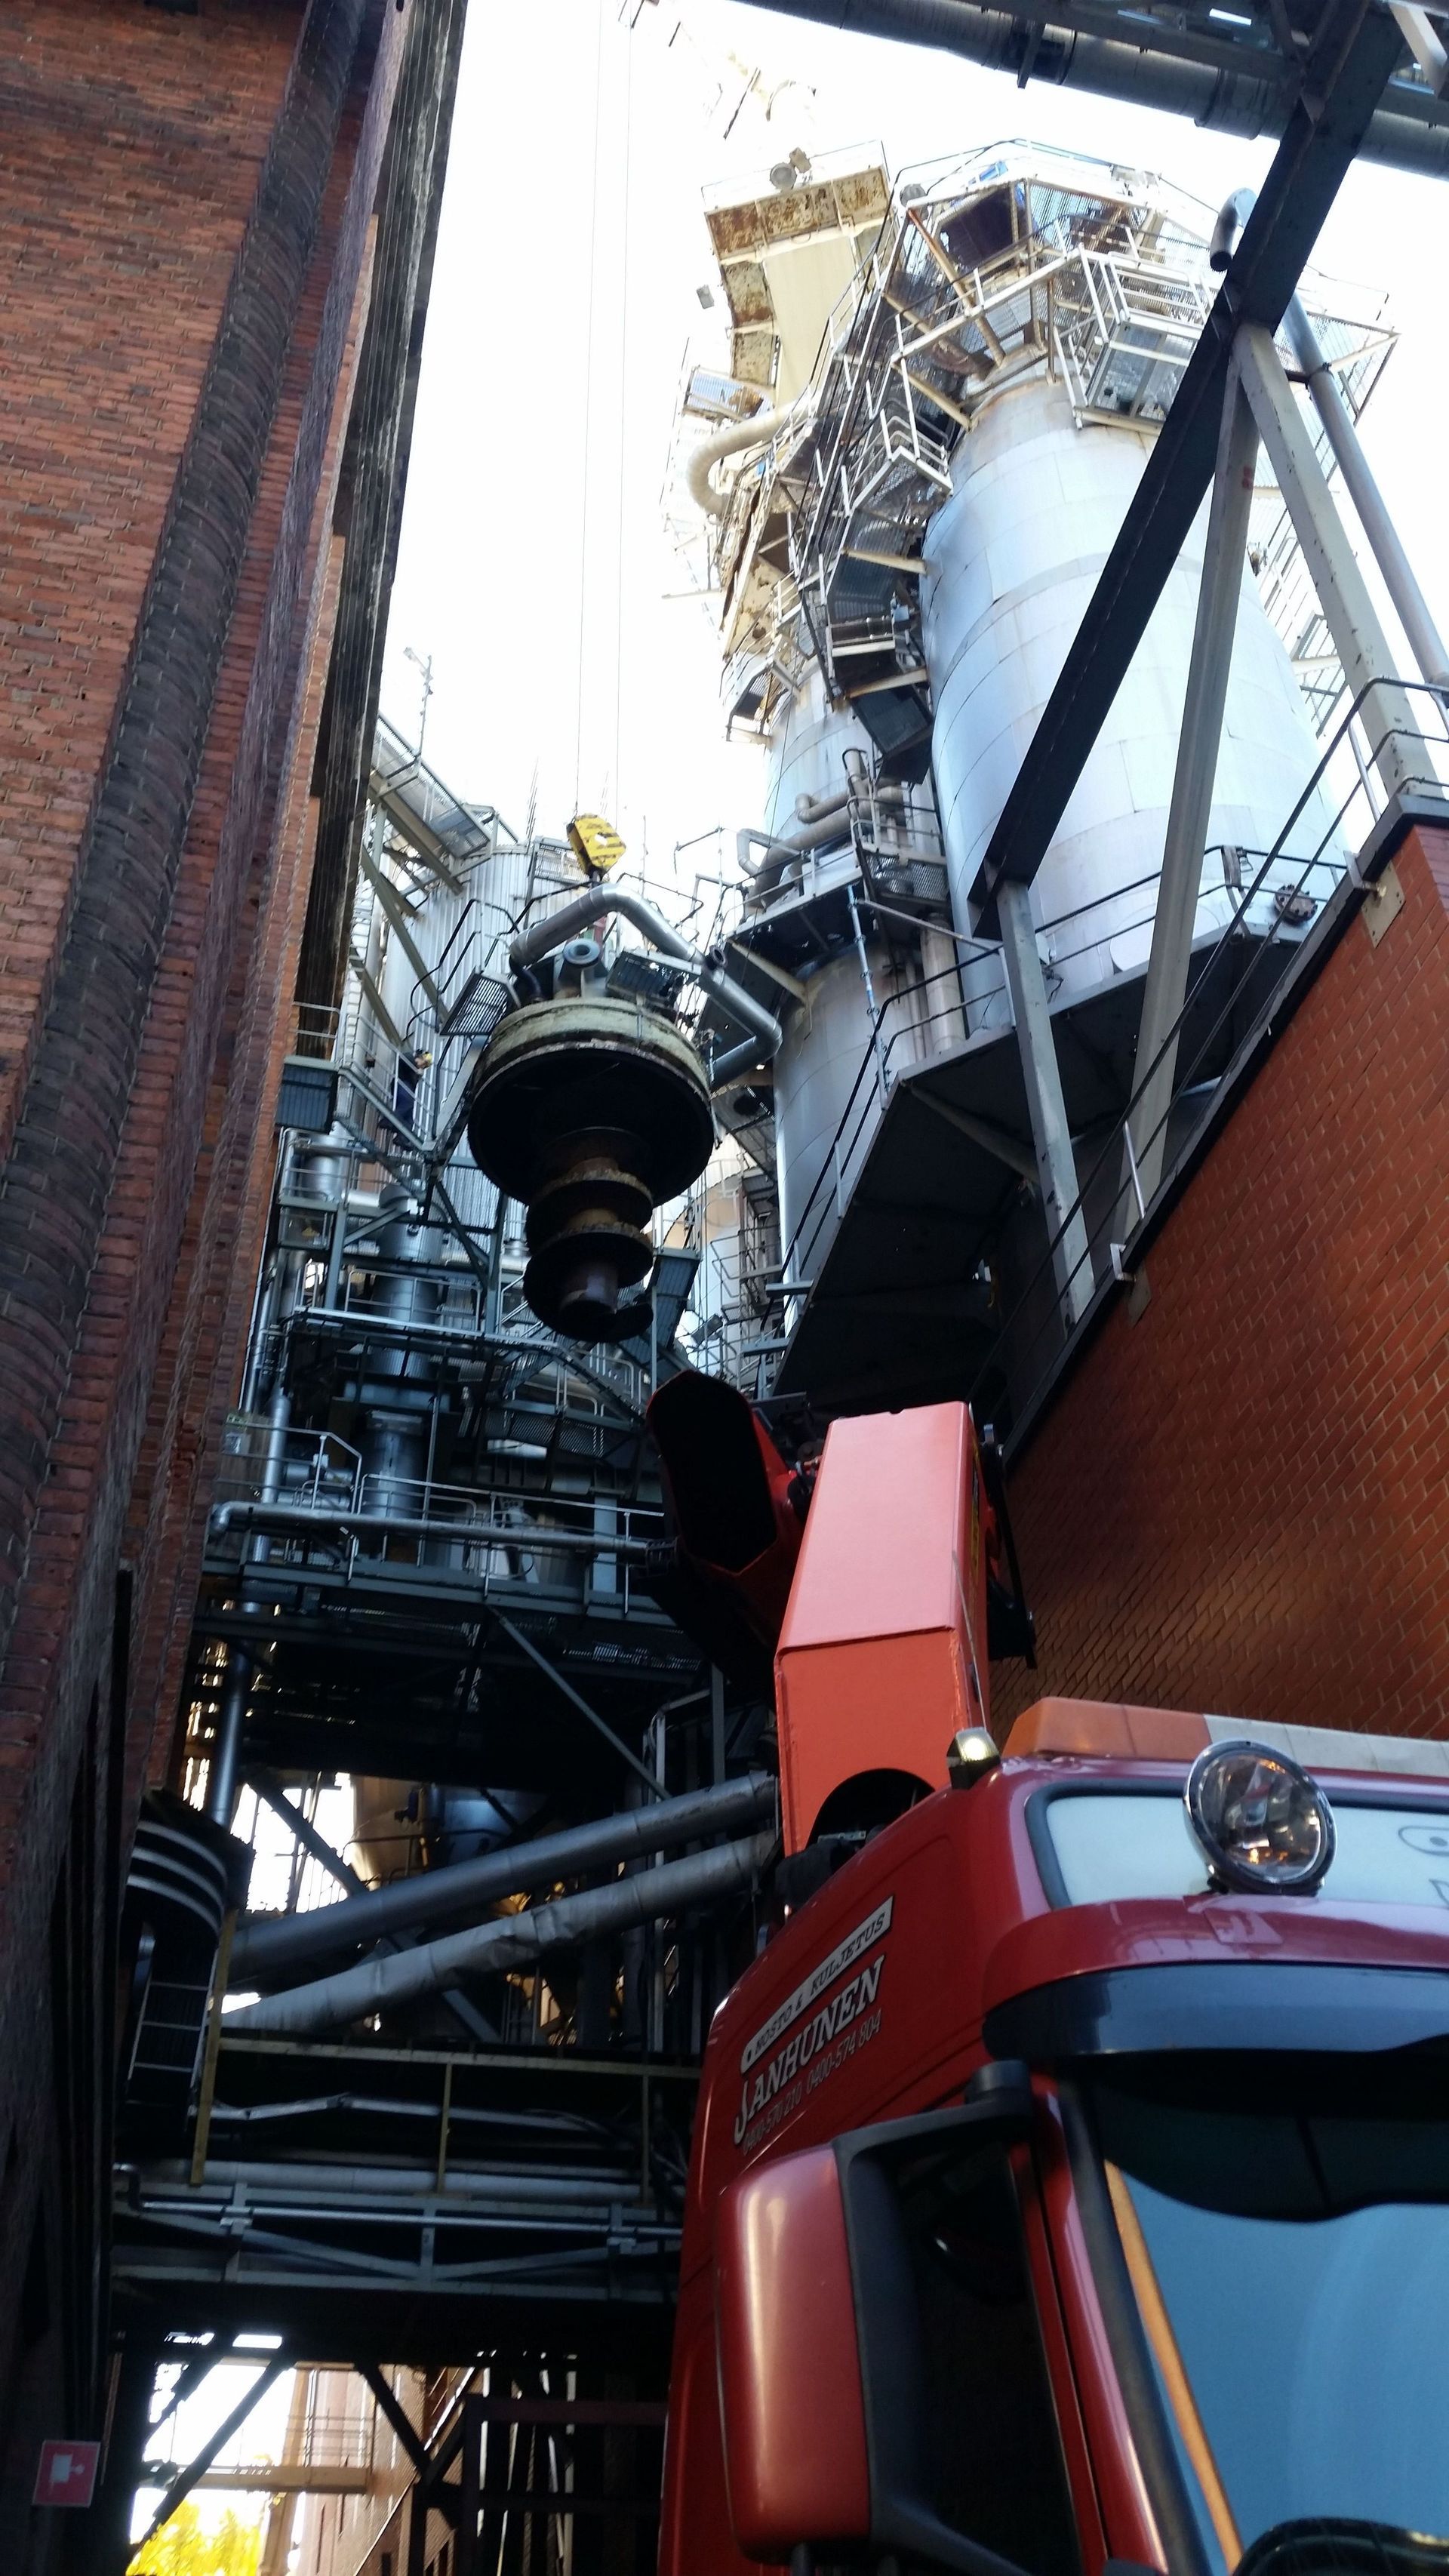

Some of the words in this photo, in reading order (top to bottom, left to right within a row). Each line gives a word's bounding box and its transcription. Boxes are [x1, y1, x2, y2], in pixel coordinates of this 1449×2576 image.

[734, 1955, 884, 2144] JANHUNEN
[755, 2005, 792, 2055] NOSTO
[810, 1912, 885, 1995] KULJETUS
